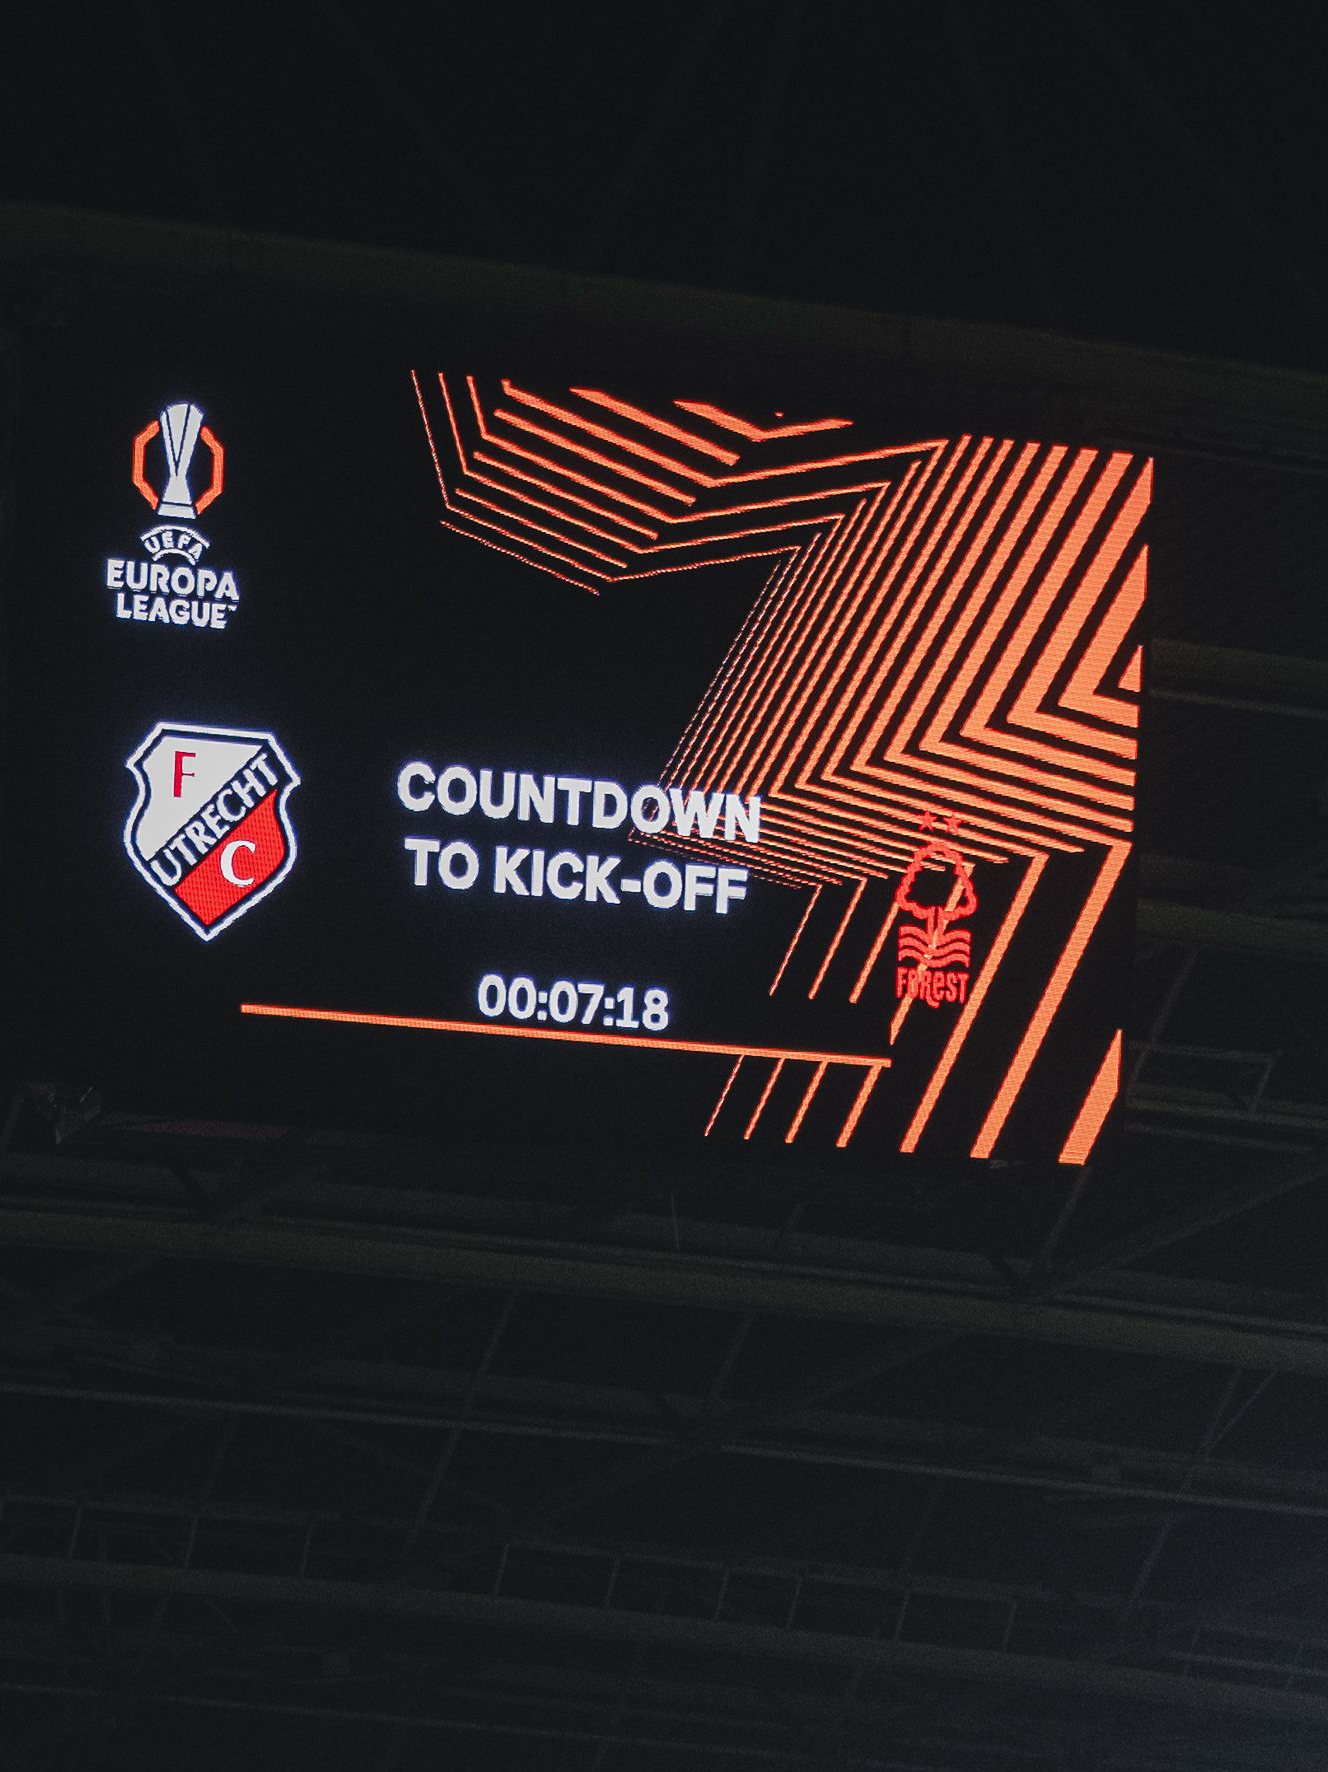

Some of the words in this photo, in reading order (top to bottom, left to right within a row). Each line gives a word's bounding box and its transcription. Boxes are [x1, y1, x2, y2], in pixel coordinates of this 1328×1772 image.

[144, 531, 204, 560] UEFA
[106, 558, 240, 601] EUROPA
[116, 593, 228, 630] LEAGUE
[173, 750, 197, 798] F
[150, 752, 279, 887] UTRECHT
[397, 761, 762, 844] COUNTDOWN
[220, 840, 256, 888] C
[404, 837, 480, 891] TO
[493, 846, 749, 915] KICK-OFF
[477, 973, 670, 1032] 00:07:18
